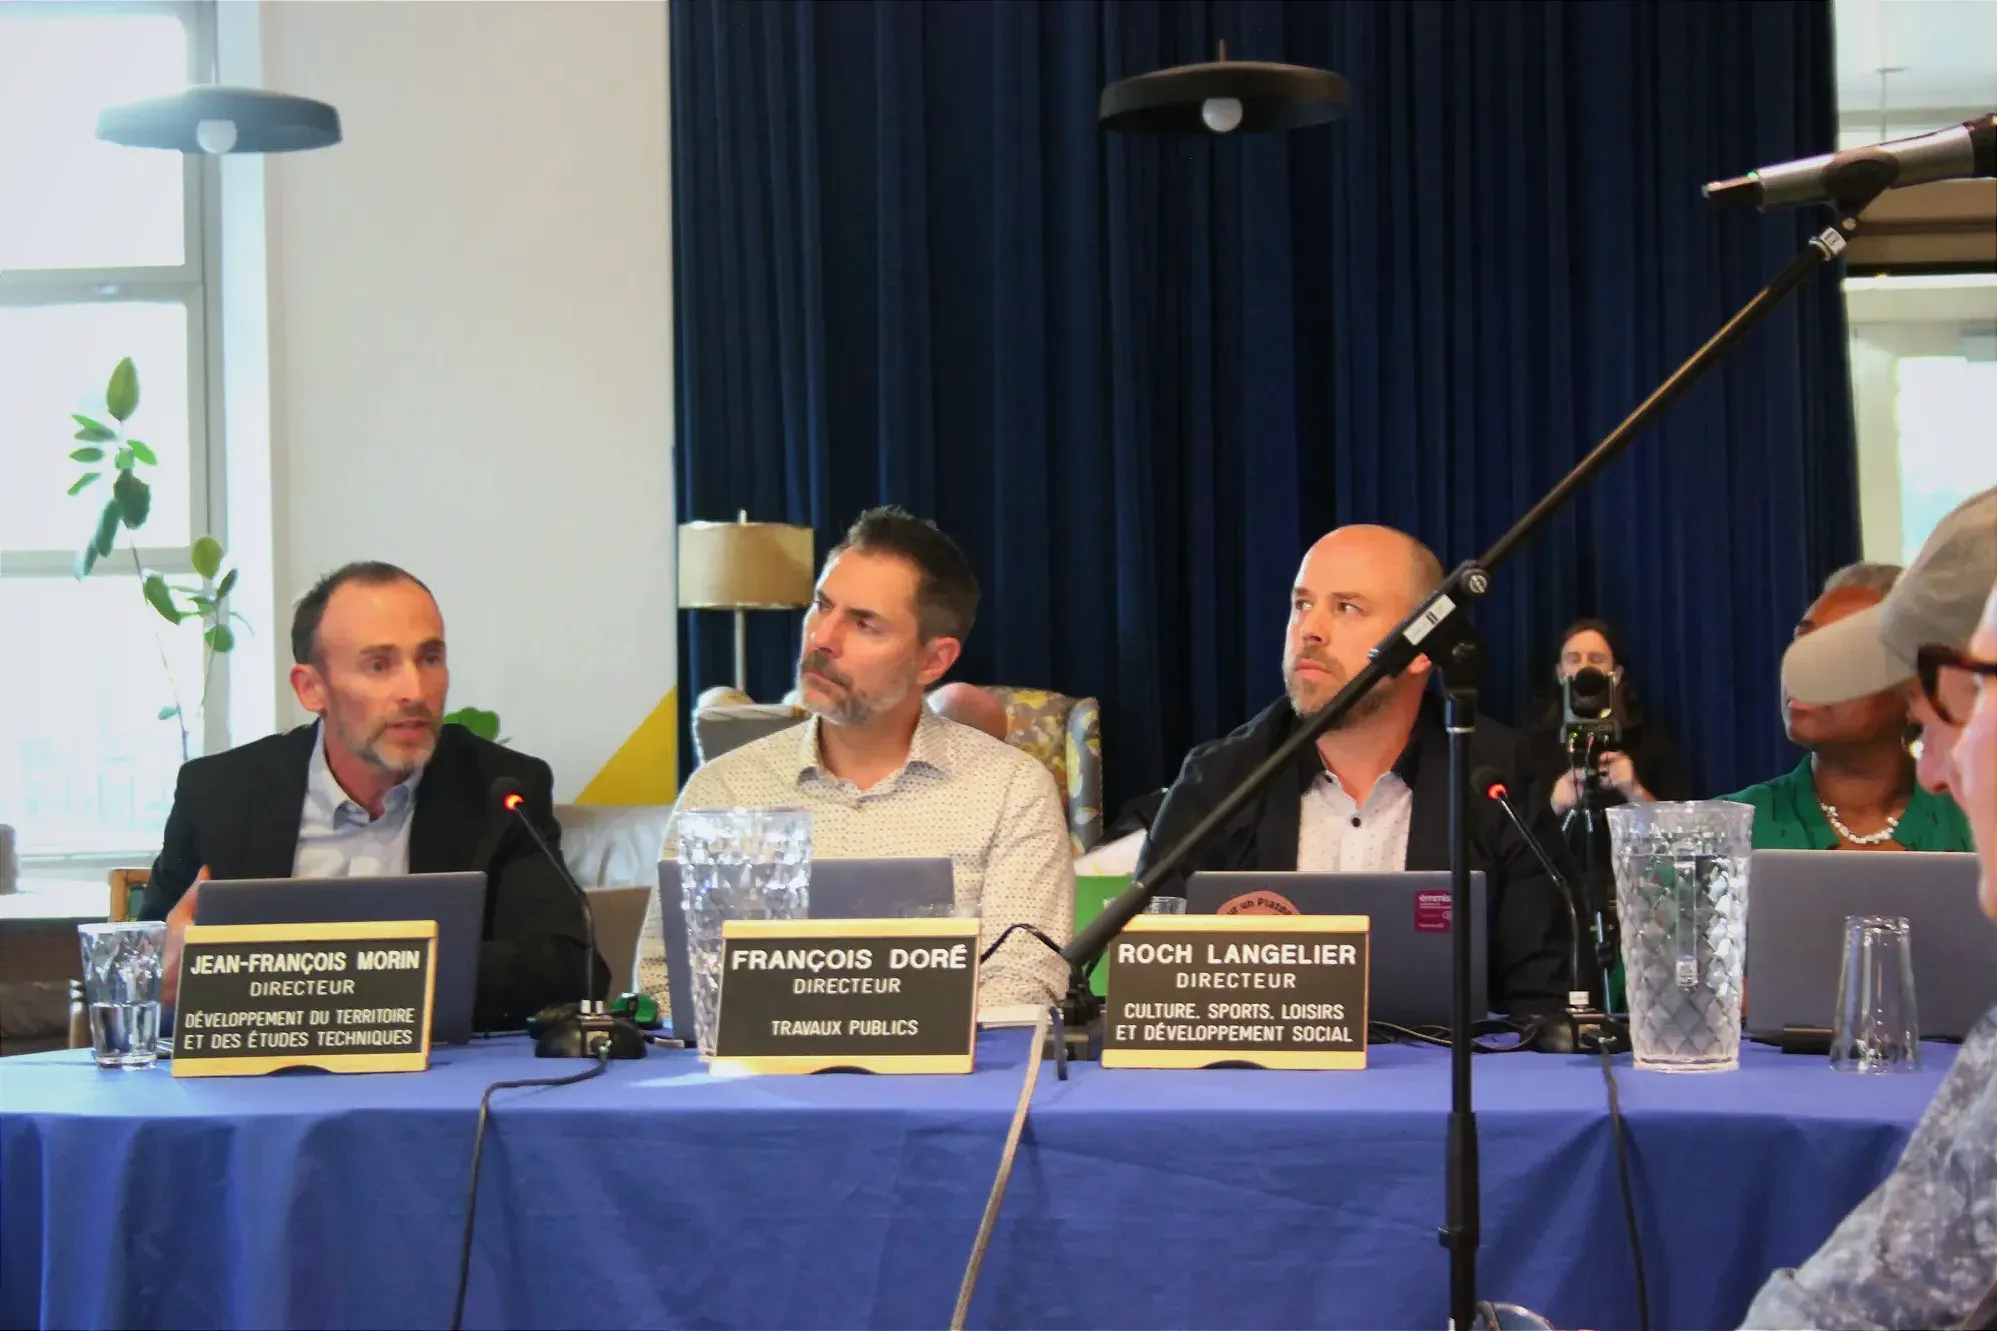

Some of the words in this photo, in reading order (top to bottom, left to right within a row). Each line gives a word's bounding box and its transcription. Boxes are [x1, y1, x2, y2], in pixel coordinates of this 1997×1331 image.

[189, 951, 347, 975] JEAN-FRANÇOIS
[356, 949, 421, 971] MORIN
[731, 948, 873, 973] FRANÇOIS
[889, 943, 968, 970] DORÉ
[1117, 943, 1194, 965] ROCH
[1206, 943, 1357, 965] LANGELIER
[249, 979, 356, 997] DIRECTEUR
[793, 977, 902, 995] DIRECTEUR
[1175, 972, 1297, 989] DIRECTEUR
[184, 1009, 305, 1029] DÉVELOPPEMENT
[309, 1009, 330, 1026] DU
[336, 1007, 416, 1025] TERRITOIRE
[1281, 1003, 1345, 1021] LOISIRS
[771, 1020, 842, 1036] TRAVAUX
[848, 1019, 919, 1036] PUBLICS
[1115, 1024, 1138, 1041] ET
[1143, 1021, 1285, 1042] DÉVELOPPEMENT
[1292, 1025, 1354, 1043] SOCIAL
[183, 1034, 205, 1050] ET
[210, 1032, 242, 1050] DES
[249, 1029, 310, 1049] ÉTUDES
[317, 1029, 413, 1047] TECHNIQUES
